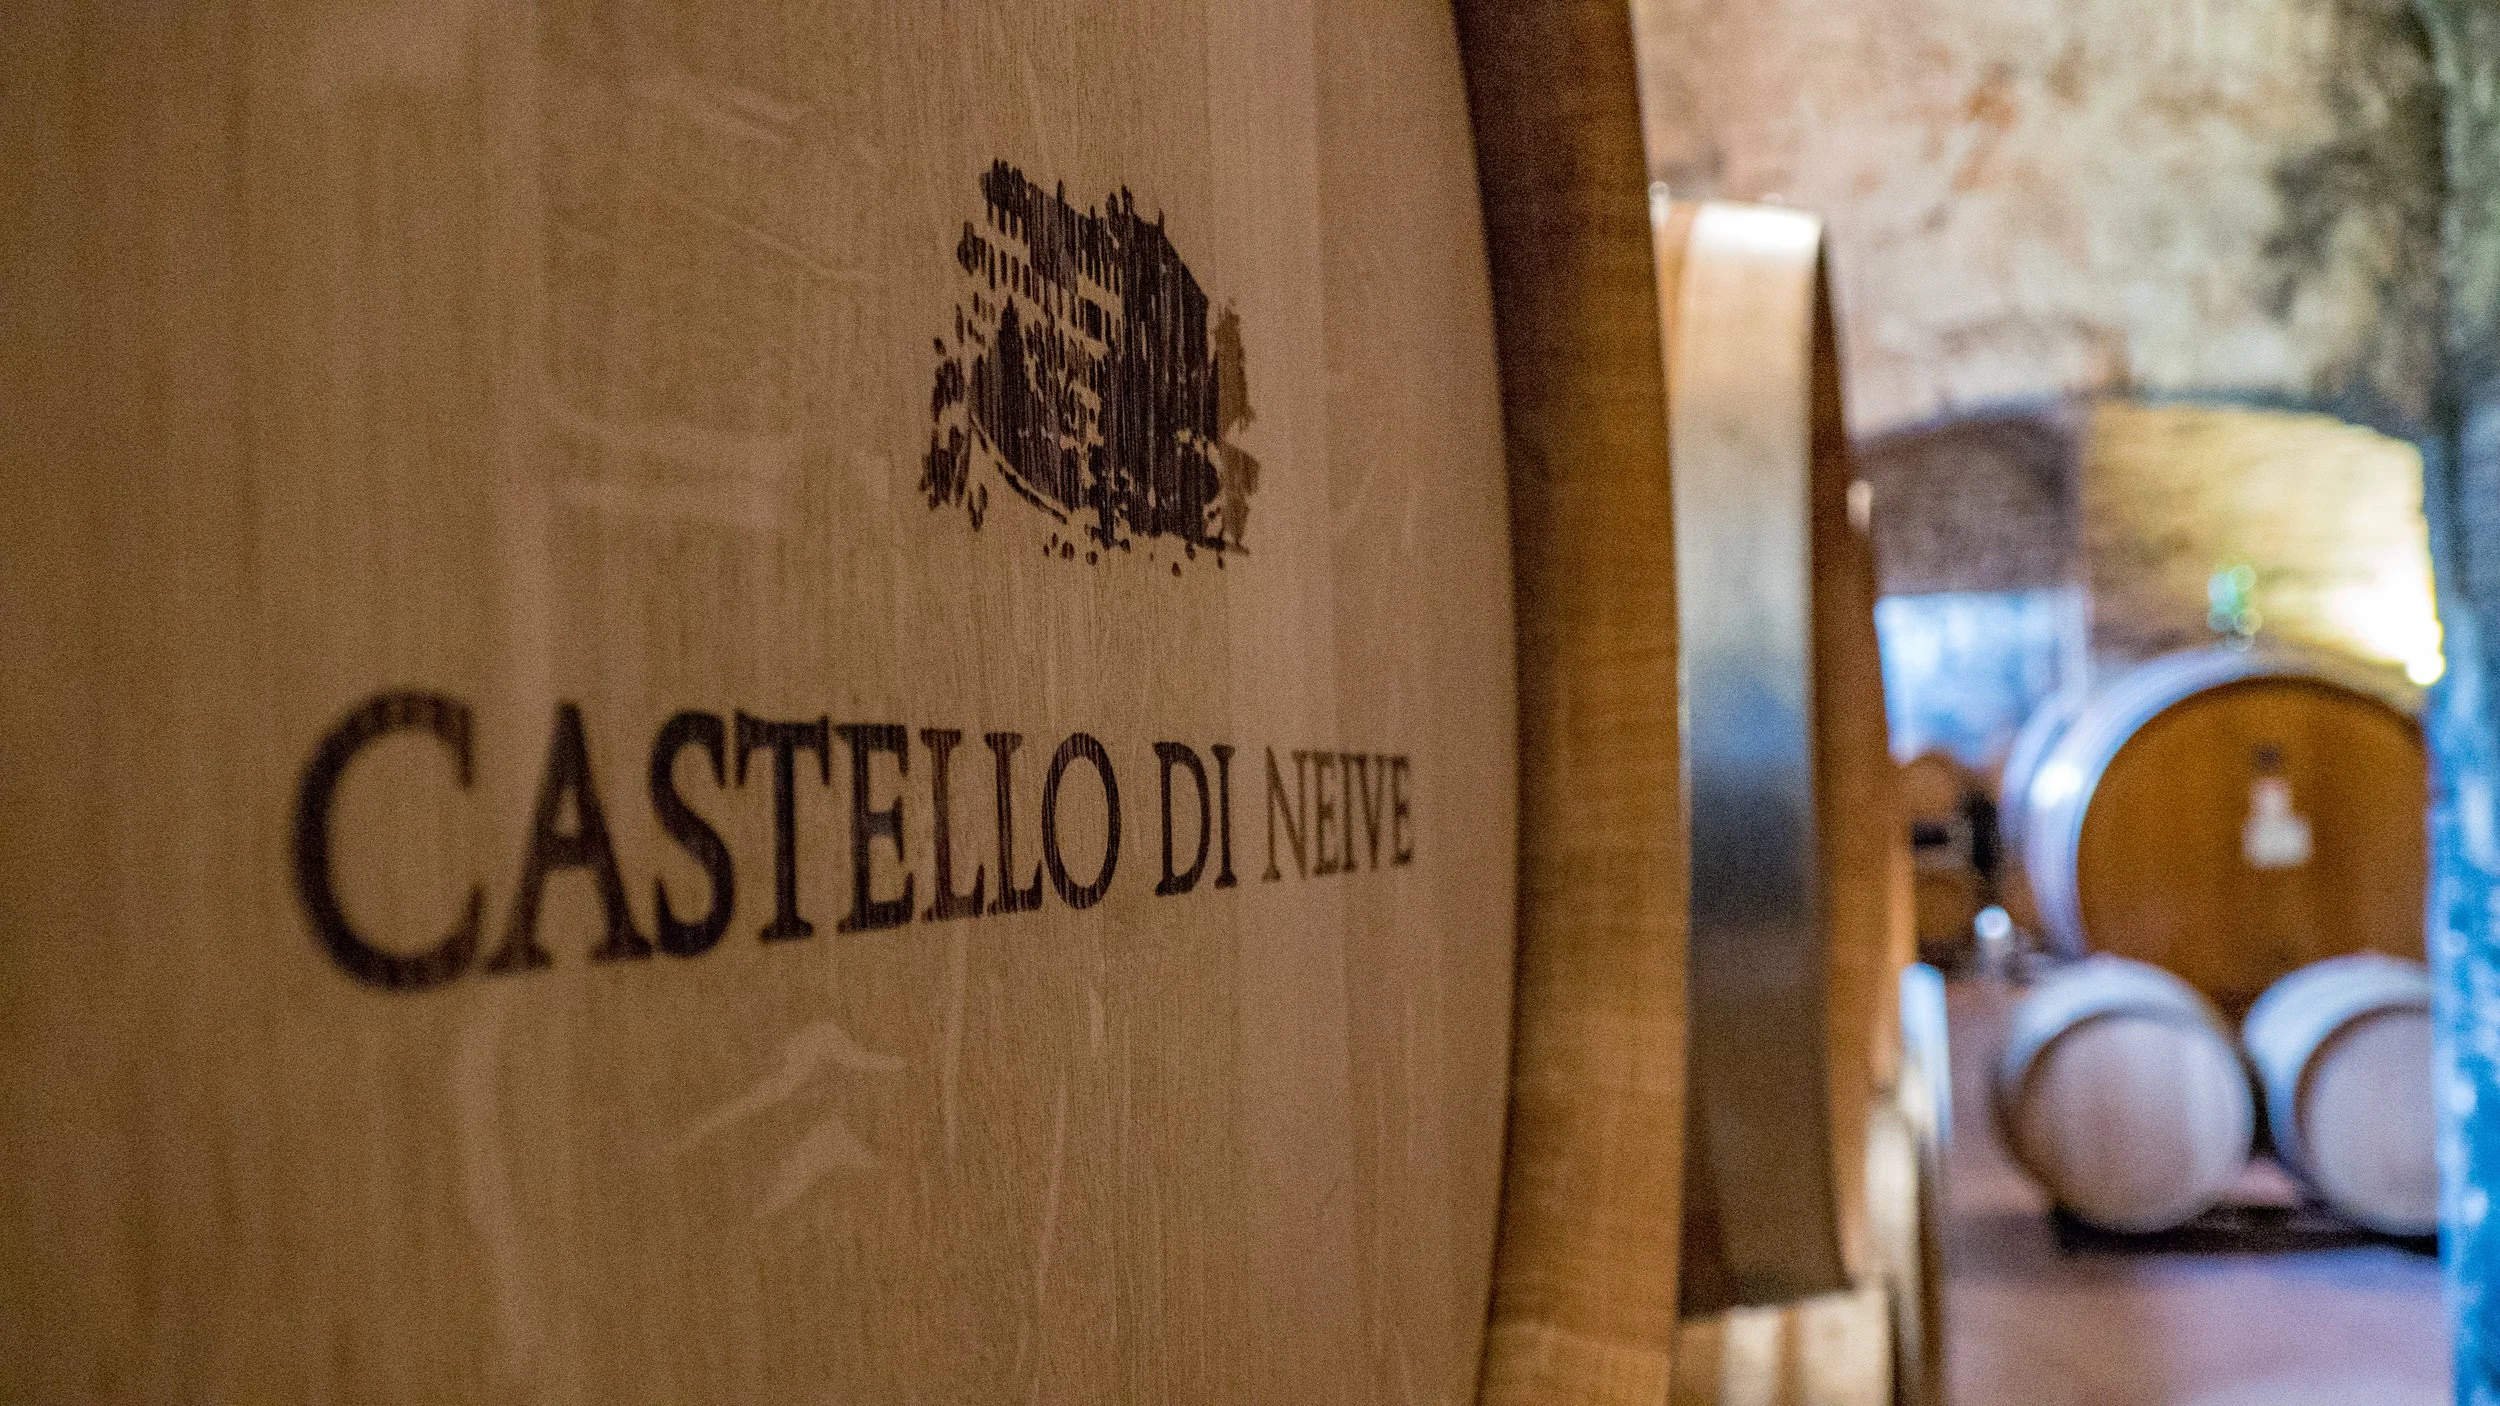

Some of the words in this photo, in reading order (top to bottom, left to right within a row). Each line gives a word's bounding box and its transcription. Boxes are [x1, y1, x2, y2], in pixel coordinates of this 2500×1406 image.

[292, 688, 1121, 991] CASTELLO
[1153, 741, 1237, 896] DI
[1261, 745, 1412, 882] NEIVE
